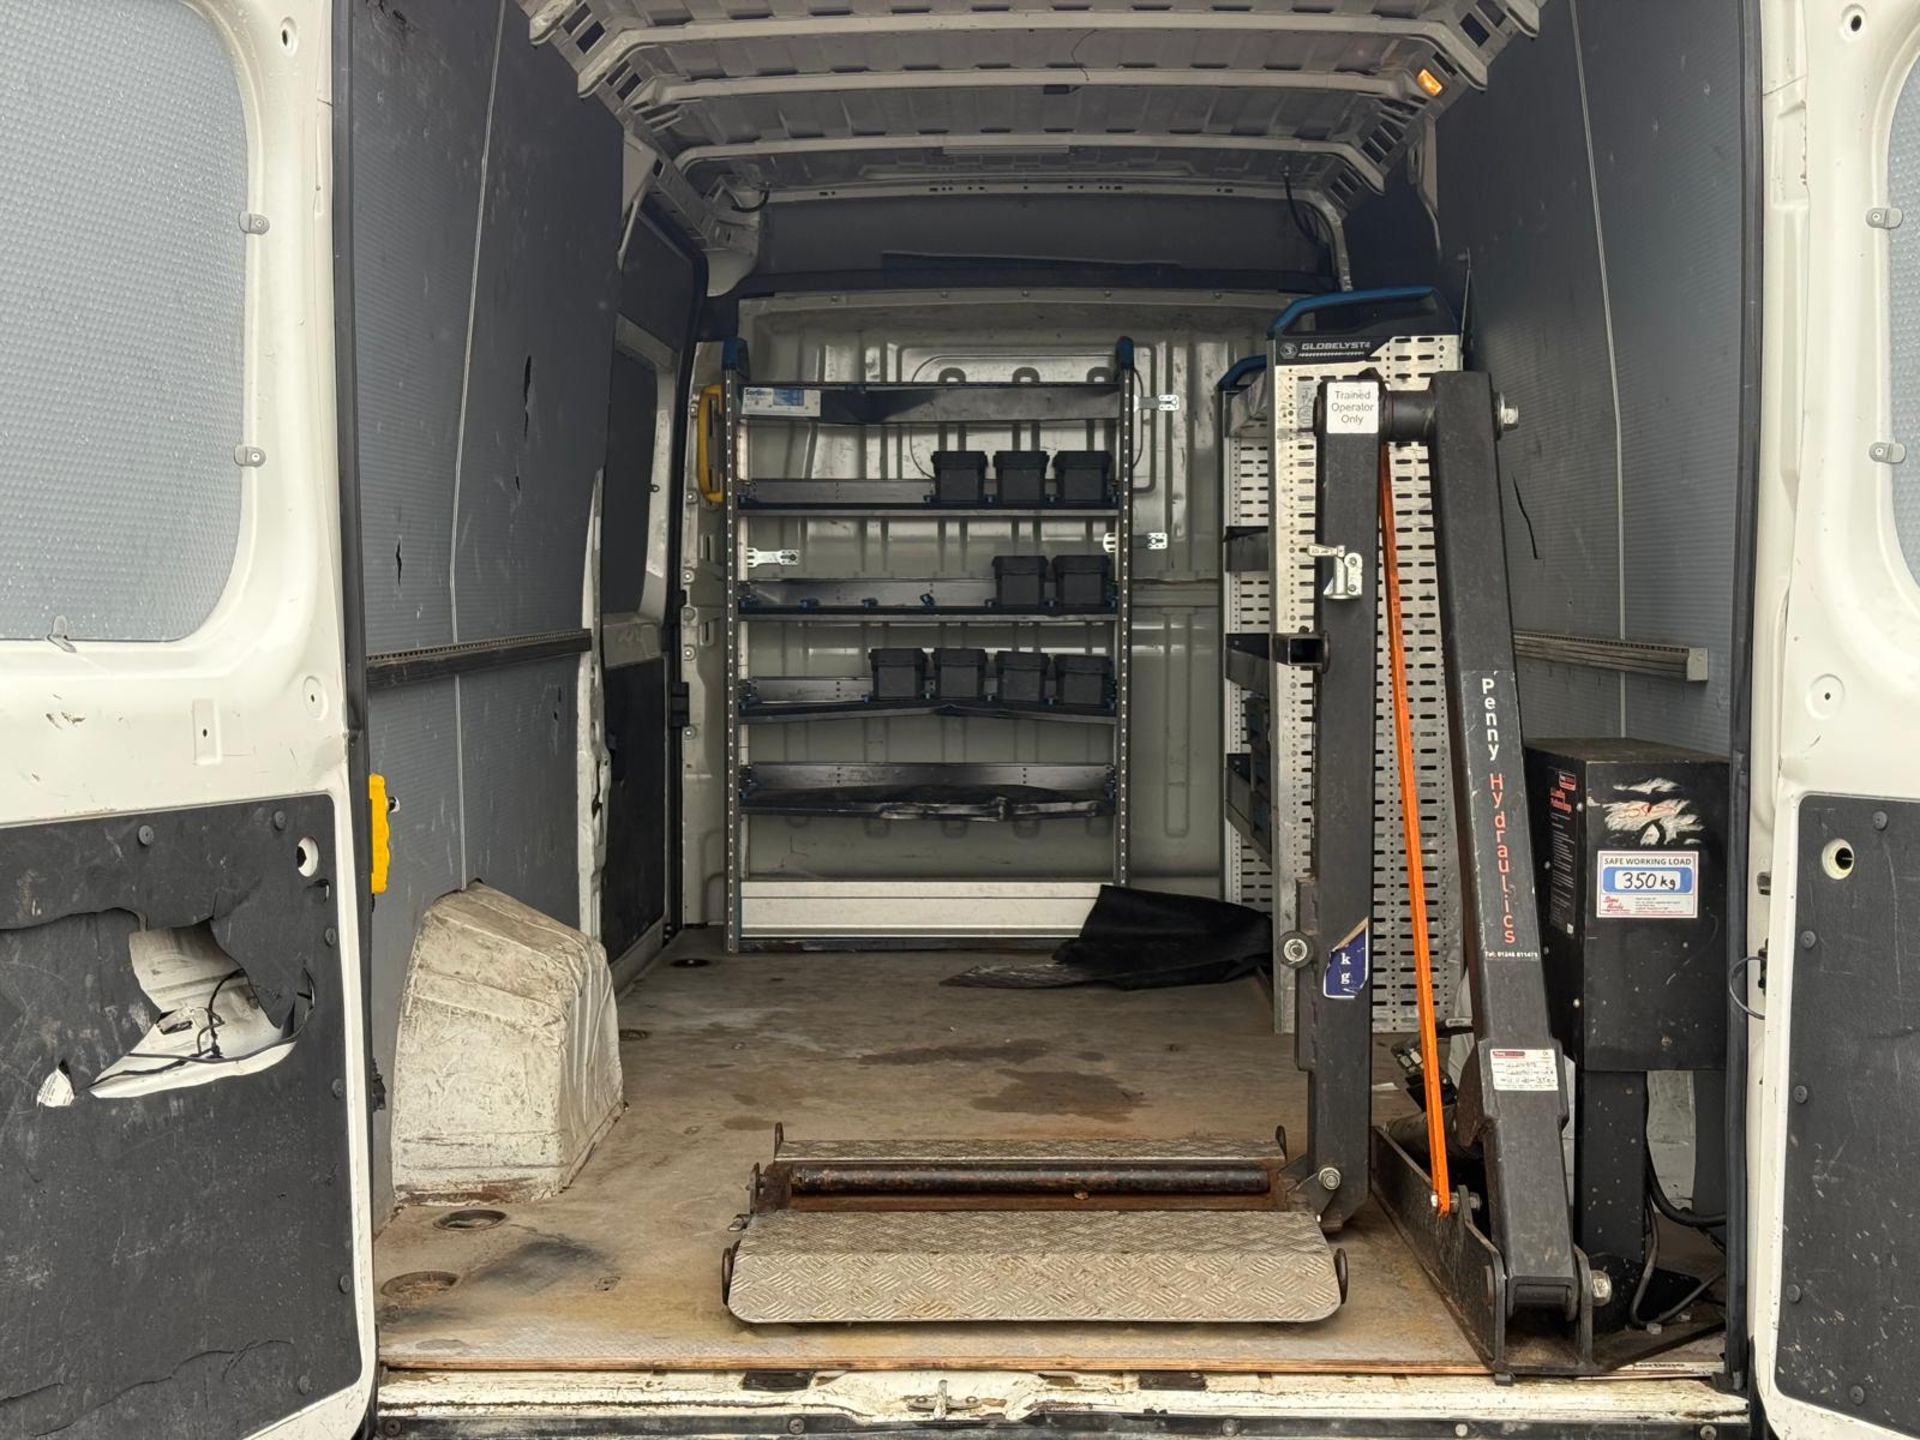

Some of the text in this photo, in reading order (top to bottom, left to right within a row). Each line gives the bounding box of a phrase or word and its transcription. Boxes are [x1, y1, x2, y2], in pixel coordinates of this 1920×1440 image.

[1334, 390, 1371, 399] Trained
[1331, 402, 1375, 413] Operator
[1341, 414, 1364, 425] Only
[1482, 678, 1516, 943] Penny Hydraulics
[1622, 872, 1676, 890] 350 kg
